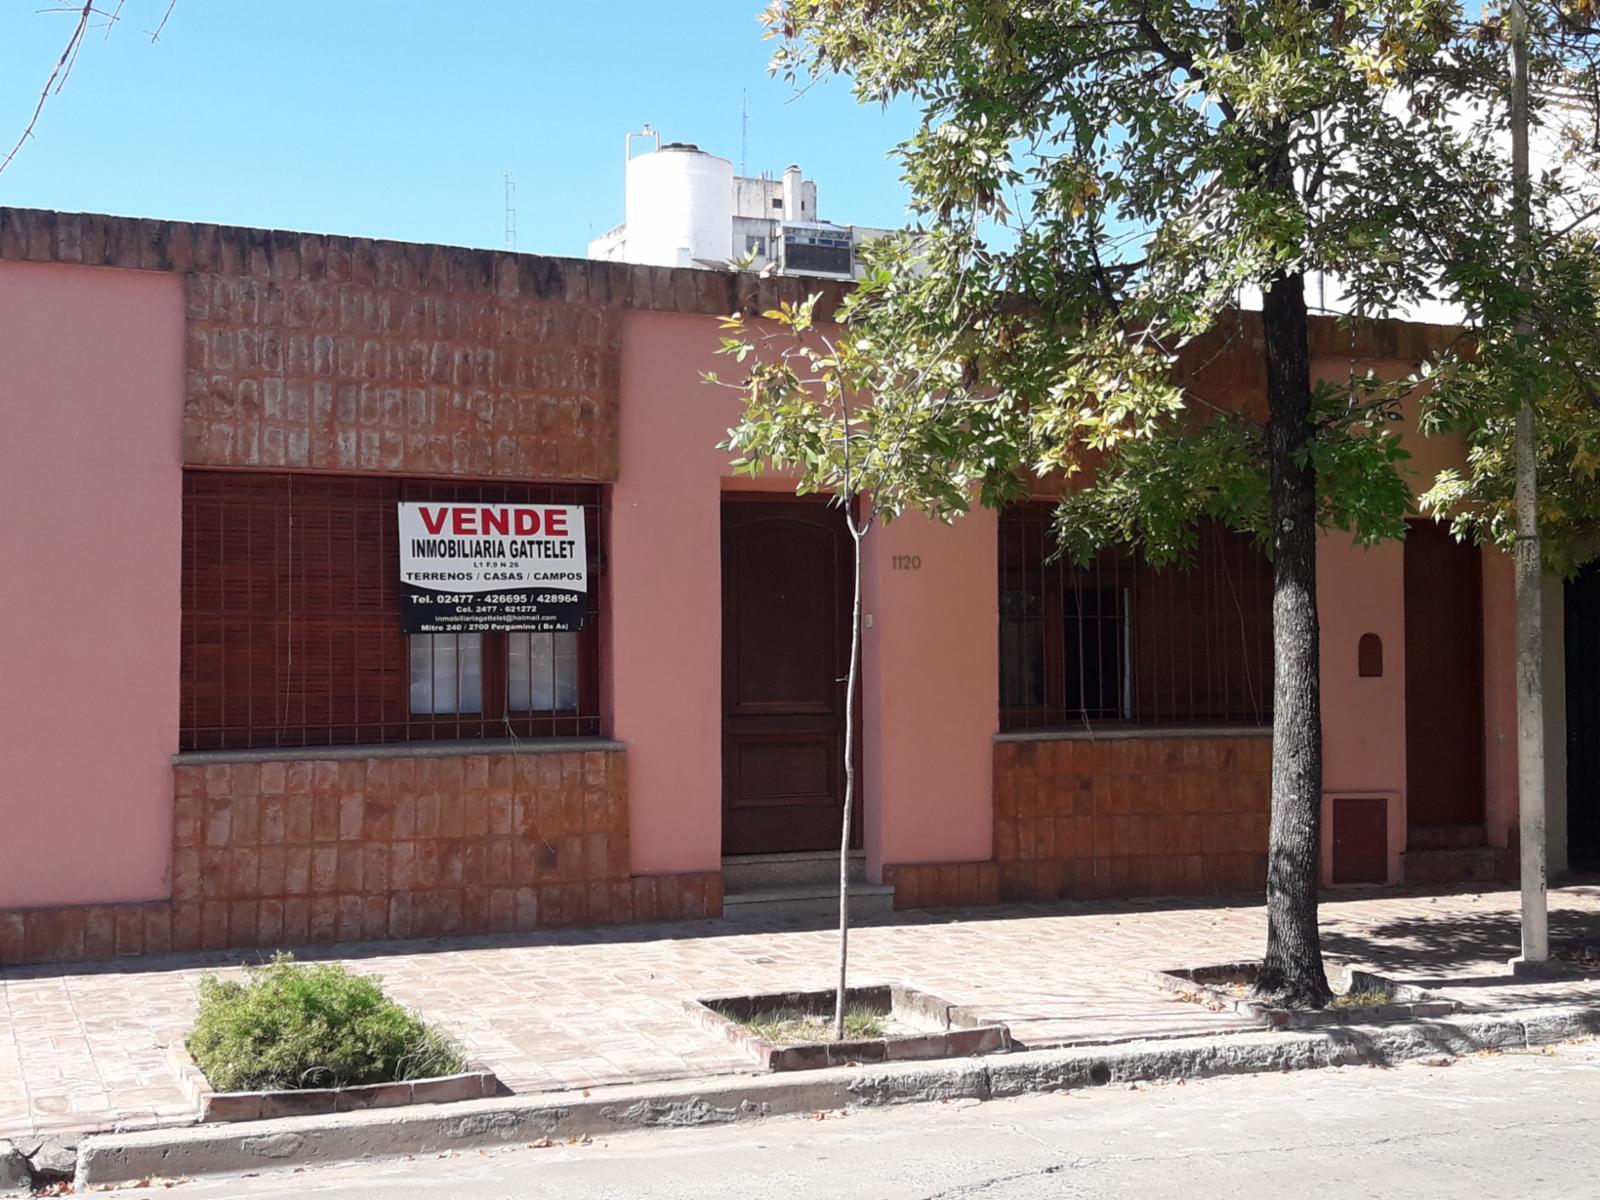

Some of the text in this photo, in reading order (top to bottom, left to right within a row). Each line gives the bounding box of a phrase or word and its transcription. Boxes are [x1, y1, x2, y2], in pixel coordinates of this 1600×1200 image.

[418, 507, 569, 536] VENDE
[411, 538, 575, 559] INMOBILIARIA GATTELET
[892, 555, 921, 570] 1120
[406, 572, 473, 580] TERRENOS
[483, 572, 524, 580] CASAS
[534, 572, 582, 580] CAMPOS
[410, 594, 434, 604] Tel.
[436, 594, 474, 604] 02477
[484, 594, 528, 604] 426695
[536, 594, 578, 603] 428964
